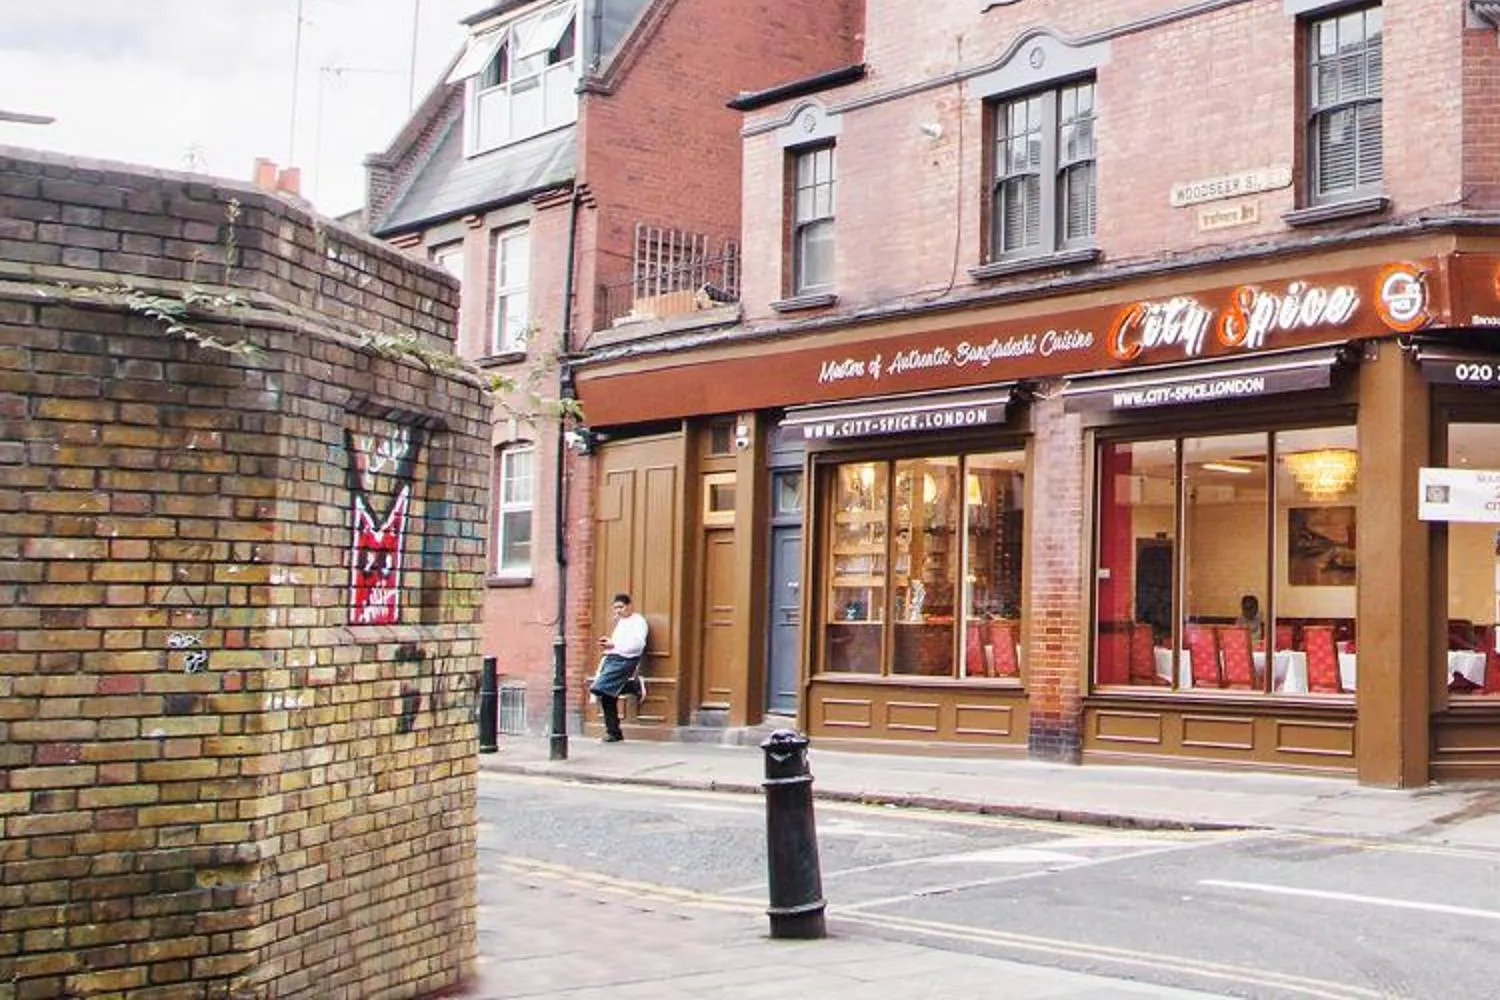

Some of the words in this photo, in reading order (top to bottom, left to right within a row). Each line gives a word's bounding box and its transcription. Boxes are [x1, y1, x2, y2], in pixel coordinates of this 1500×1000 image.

[1107, 296, 1213, 360] City
[1218, 281, 1361, 348] Spice
[868, 354, 881, 379] of
[1039, 329, 1094, 356] Cuisine
[1456, 363, 1493, 382] 020
[1113, 376, 1265, 407] WWW.CITY-SPICE.LONDON
[803, 408, 988, 438] WWW.CITY-SPICE.LONDON
